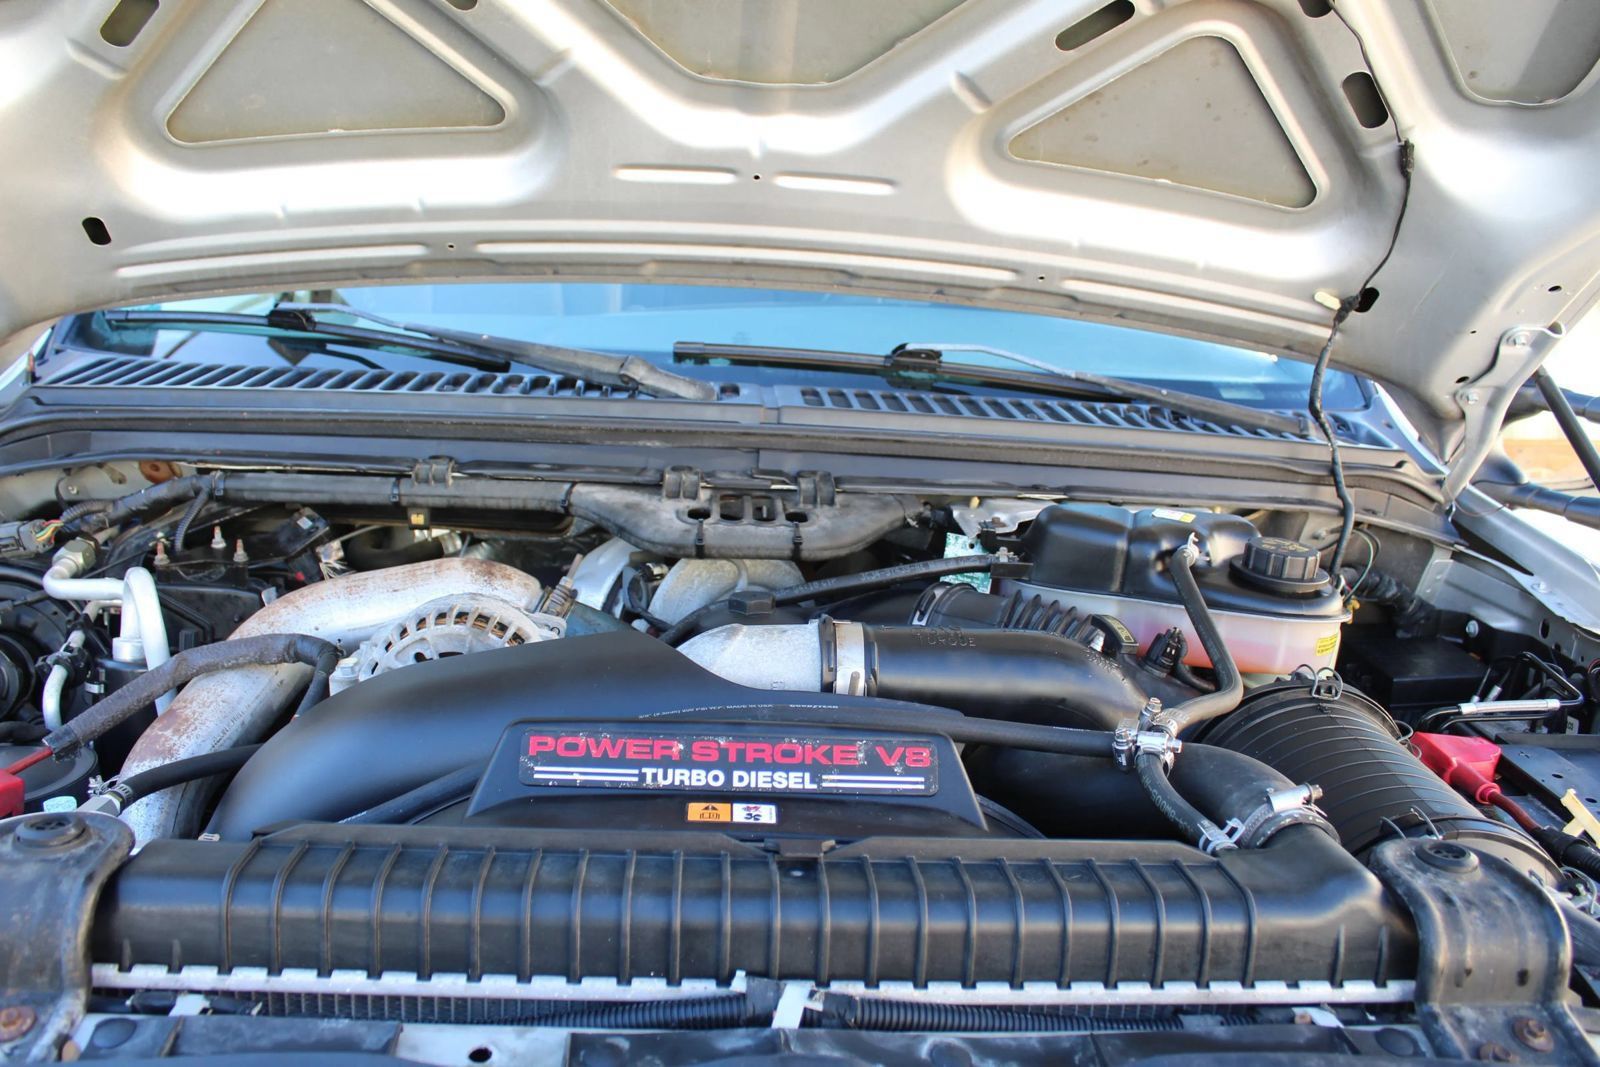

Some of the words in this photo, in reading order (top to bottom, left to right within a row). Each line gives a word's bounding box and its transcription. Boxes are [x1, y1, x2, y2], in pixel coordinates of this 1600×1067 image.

[528, 735, 681, 761] POWER
[691, 739, 859, 766] STROKE
[875, 745, 932, 768] V8
[641, 767, 725, 787] TURBO
[733, 770, 818, 790] DIESEL
